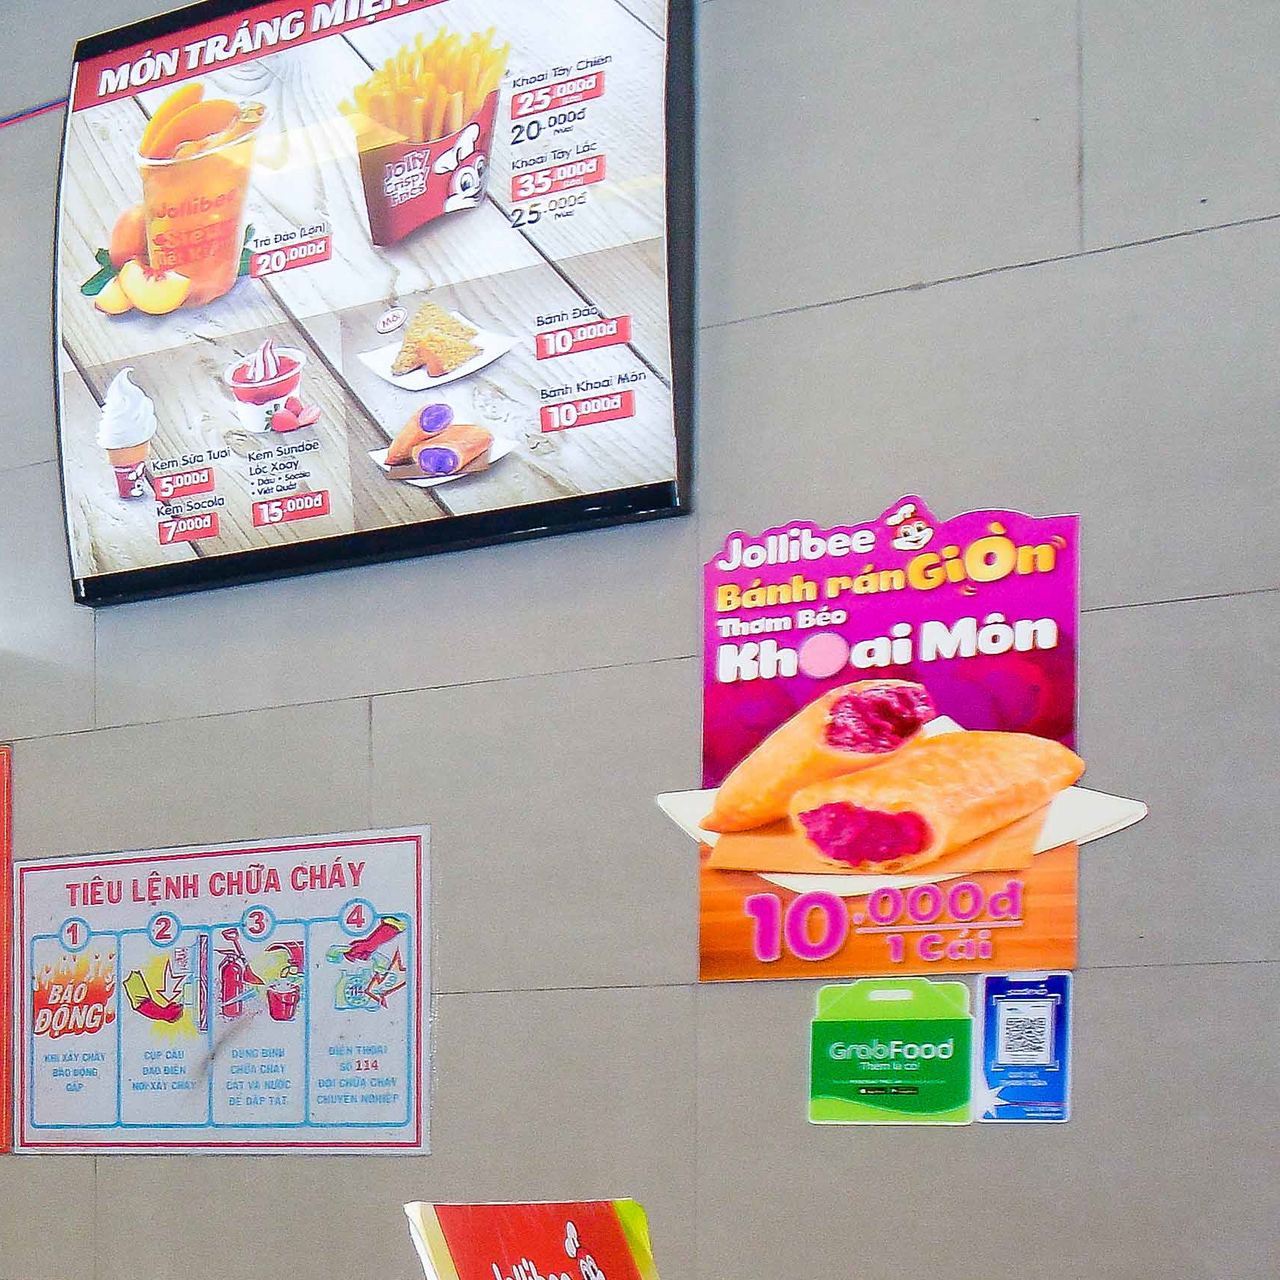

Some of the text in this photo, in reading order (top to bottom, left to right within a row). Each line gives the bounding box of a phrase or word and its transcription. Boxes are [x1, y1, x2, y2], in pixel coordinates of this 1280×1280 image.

[97, 7, 308, 98] MÓN TRÁNG
[511, 71, 549, 90] Khoai
[515, 74, 598, 117] 25.000đ
[510, 106, 588, 146] 20.000đ
[511, 153, 548, 172] Khoai
[516, 157, 600, 199] 35.000đ
[511, 190, 588, 229] 25.000đ
[274, 228, 298, 246] Đào
[256, 238, 328, 276] 20.000đ
[536, 308, 570, 327] Bánh
[542, 320, 619, 356] 10.000đ
[575, 374, 614, 394] Khoai
[547, 394, 624, 430] 10.000đ
[151, 458, 179, 473] Kem
[247, 439, 321, 464] Kem Sundae
[159, 468, 210, 498] 5.000đ
[156, 495, 226, 518] Kem Socola
[258, 493, 325, 525] 15.000đ
[162, 514, 213, 543] 7.000đ
[717, 525, 876, 573] Jollibee
[716, 573, 818, 613] Bánh
[826, 561, 906, 600] rán
[716, 604, 848, 639] Thơm Béo
[920, 610, 1060, 663] Môn
[65, 856, 367, 907] TIÊU LỆNH CHỮA CHÁY
[153, 916, 173, 941] 2
[248, 911, 266, 935] 3
[345, 904, 366, 929] 4
[743, 877, 1026, 965] 10.000đ
[66, 922, 80, 946] 1
[885, 926, 994, 964] 1 Cái
[47, 978, 89, 1006] BÁO
[32, 1001, 107, 1037] ĐỘNG
[828, 1038, 955, 1060] GrabFood
[354, 1059, 380, 1072] 114
